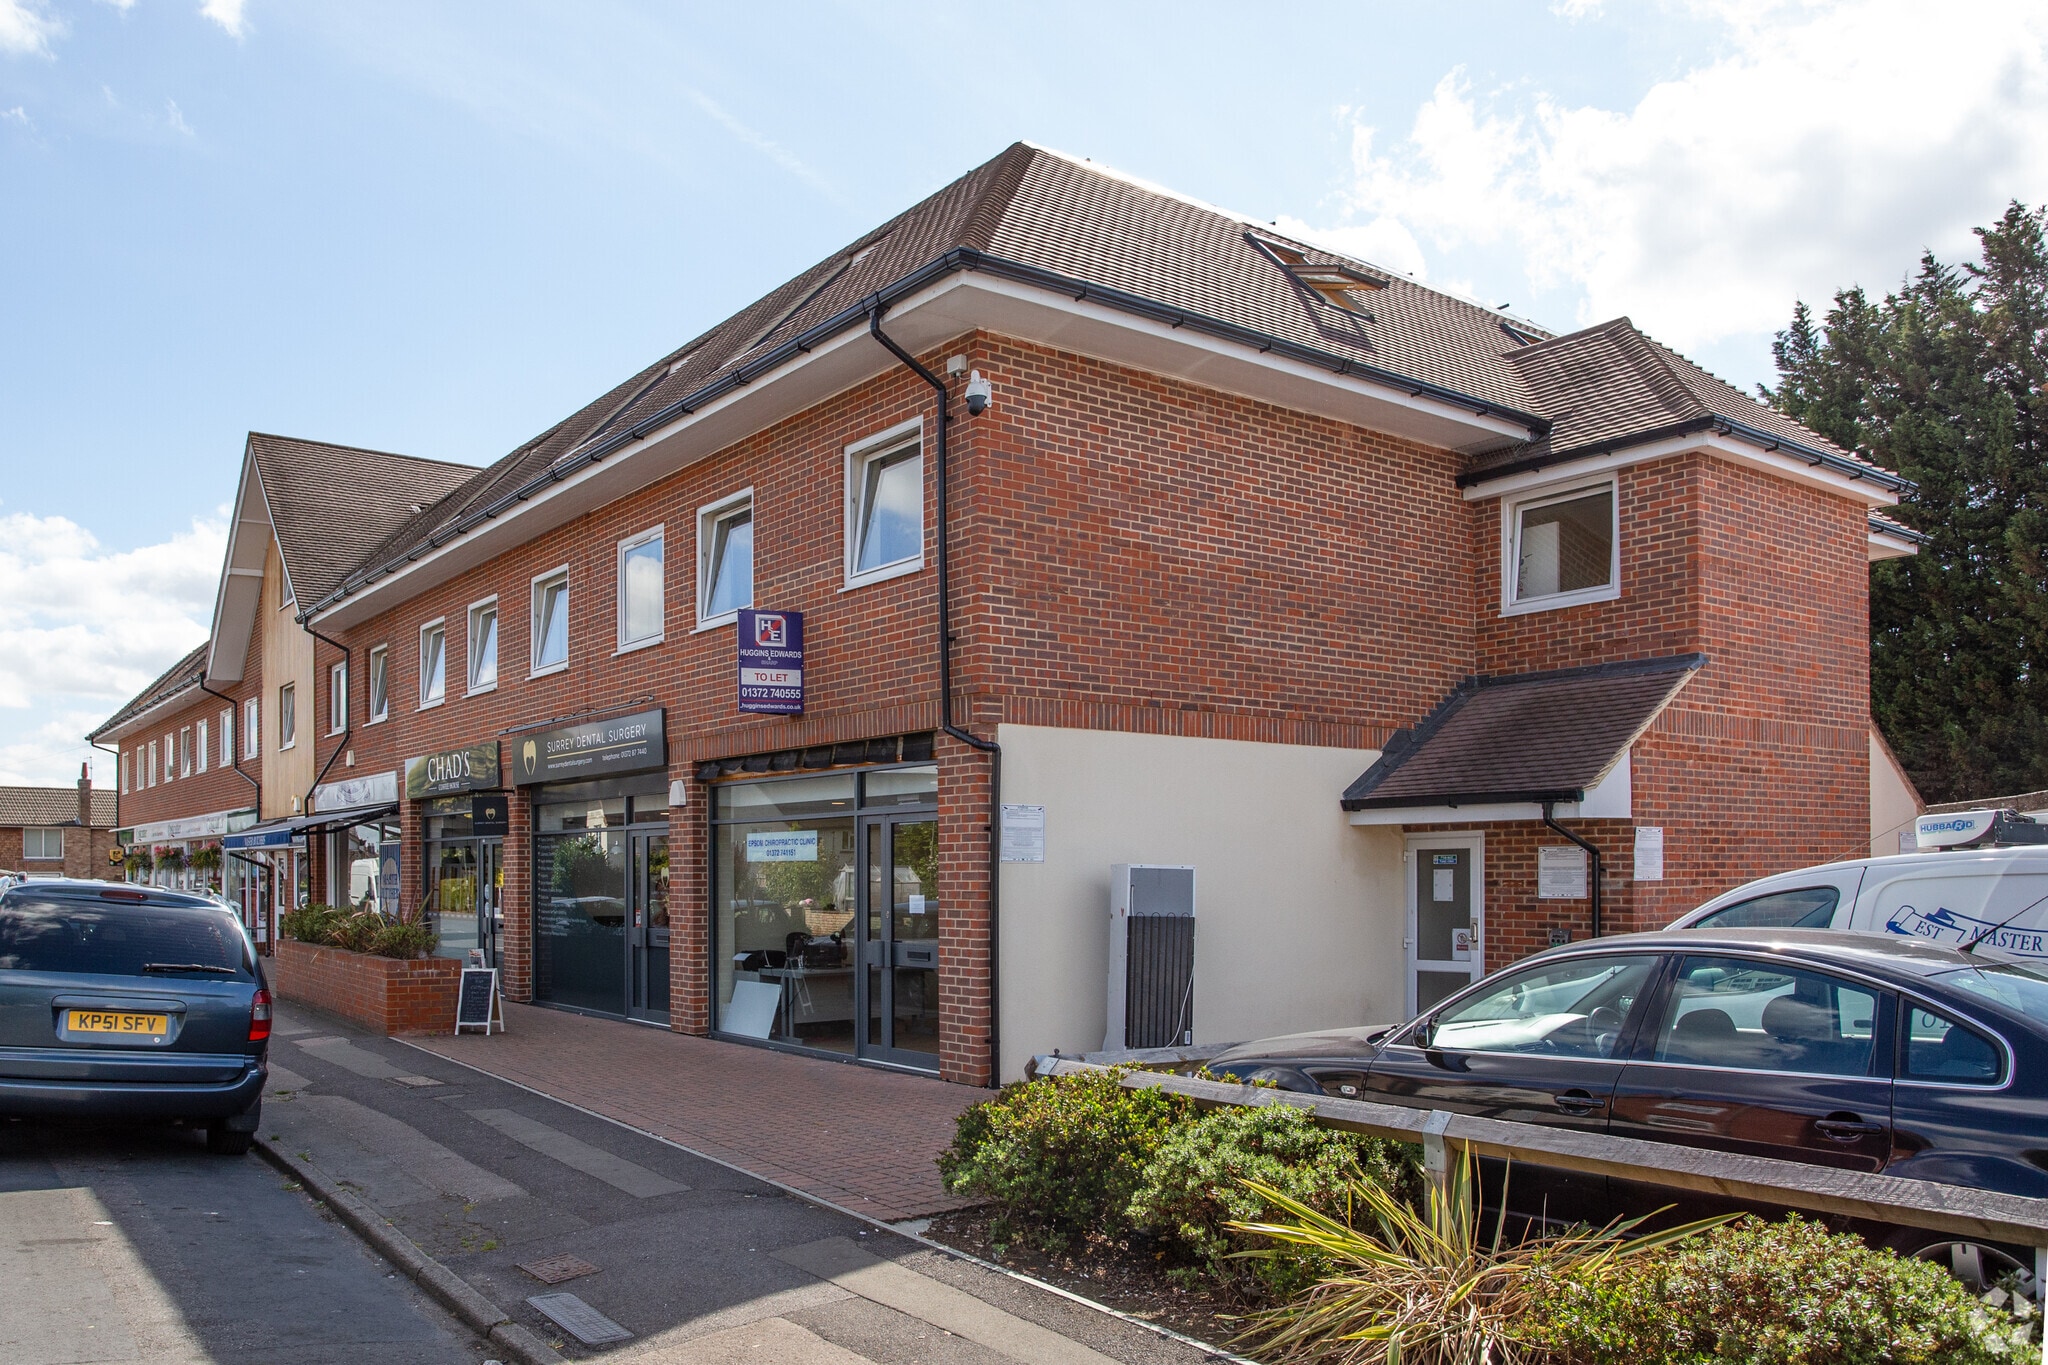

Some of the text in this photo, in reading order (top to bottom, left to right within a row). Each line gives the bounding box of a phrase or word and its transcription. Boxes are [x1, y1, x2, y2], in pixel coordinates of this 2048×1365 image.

[740, 648, 802, 659] HUGGINS EDWARDS
[754, 672, 788, 682] TO LET
[742, 687, 801, 699] 01372 740555
[547, 724, 647, 753] SURREY DENTAL SURGERY
[428, 751, 471, 782] CHAD'S
[1920, 819, 1974, 832] HUBBARD
[764, 839, 798, 847] CHIROPRACTIC
[800, 837, 816, 846] CLINIC
[766, 849, 780, 857] 01372
[1913, 920, 1944, 940] EST
[1969, 926, 2043, 952] MASTER
[78, 1014, 156, 1032] KP51 SFV
